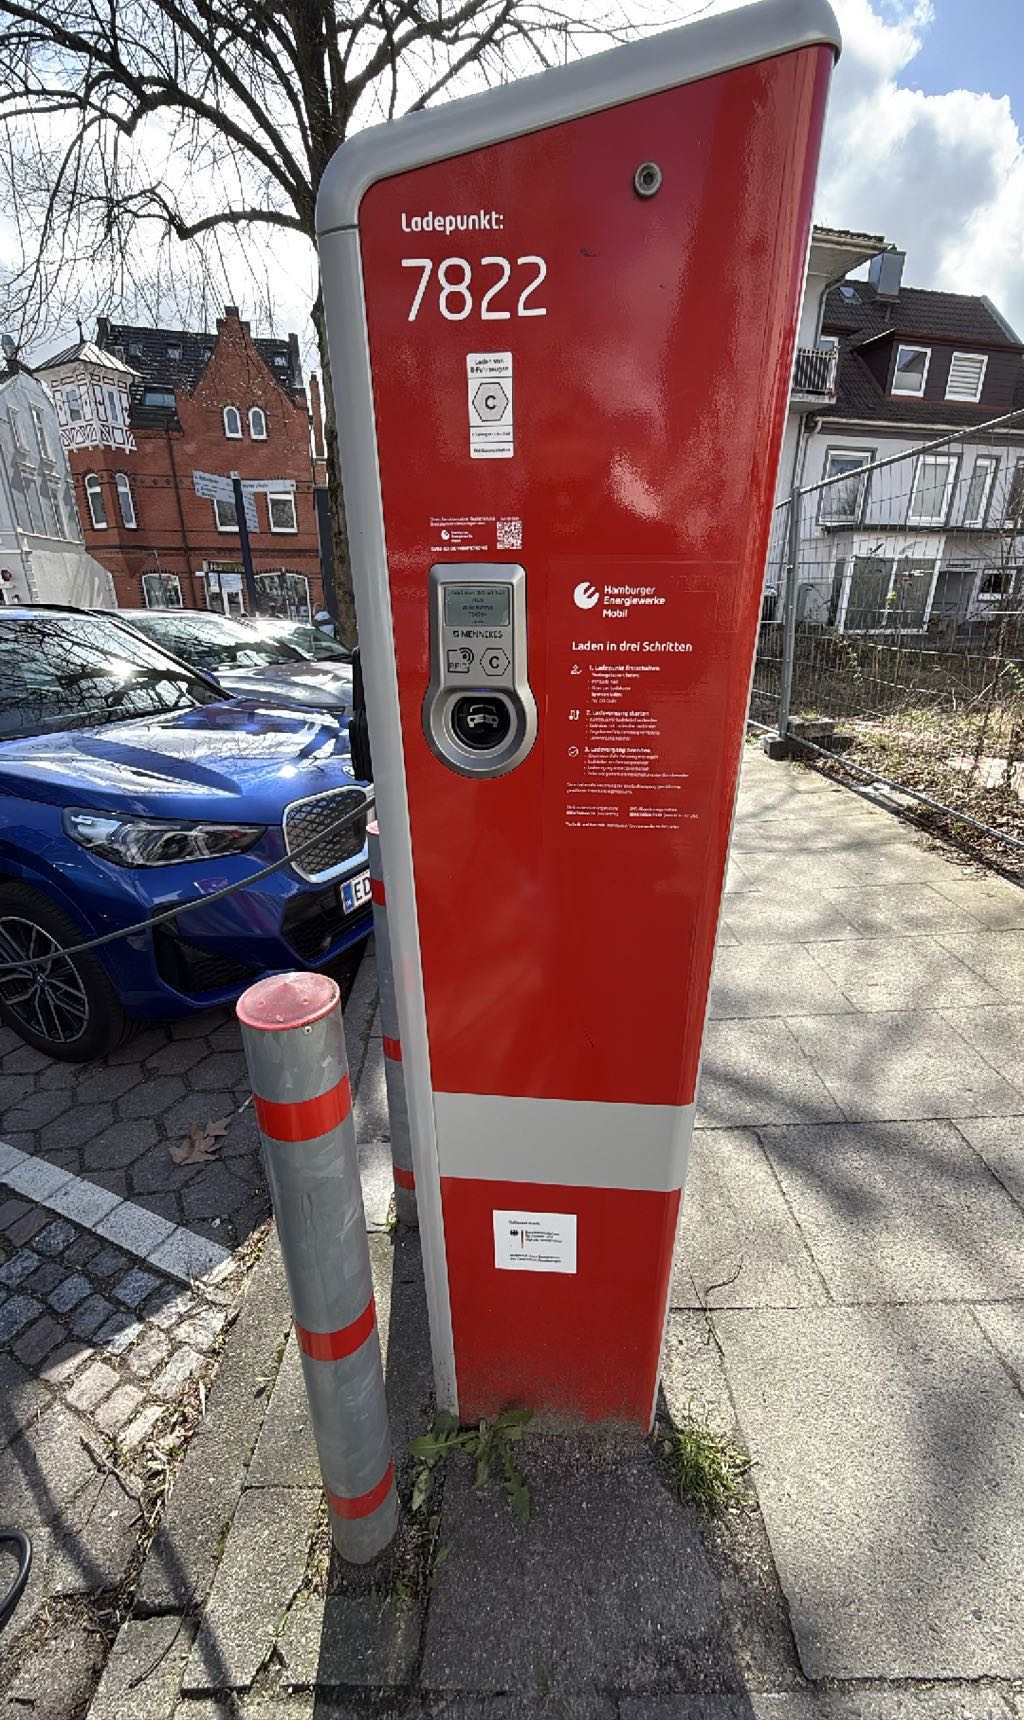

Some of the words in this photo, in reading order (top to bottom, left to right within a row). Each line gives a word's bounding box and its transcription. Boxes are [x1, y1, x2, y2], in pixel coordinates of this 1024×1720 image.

[401, 209, 504, 235] Ladepunkt:
[401, 255, 547, 322] 7822
[484, 394, 496, 411] C
[604, 585, 656, 596] Hamburger
[603, 596, 666, 606] Energiewerke
[602, 608, 628, 618] Mobil
[461, 630, 503, 639] MENNEKES
[572, 641, 604, 651] Laden
[606, 641, 617, 651] in
[619, 640, 640, 652] drei
[642, 641, 693, 652] Schritten
[488, 655, 500, 669] C
